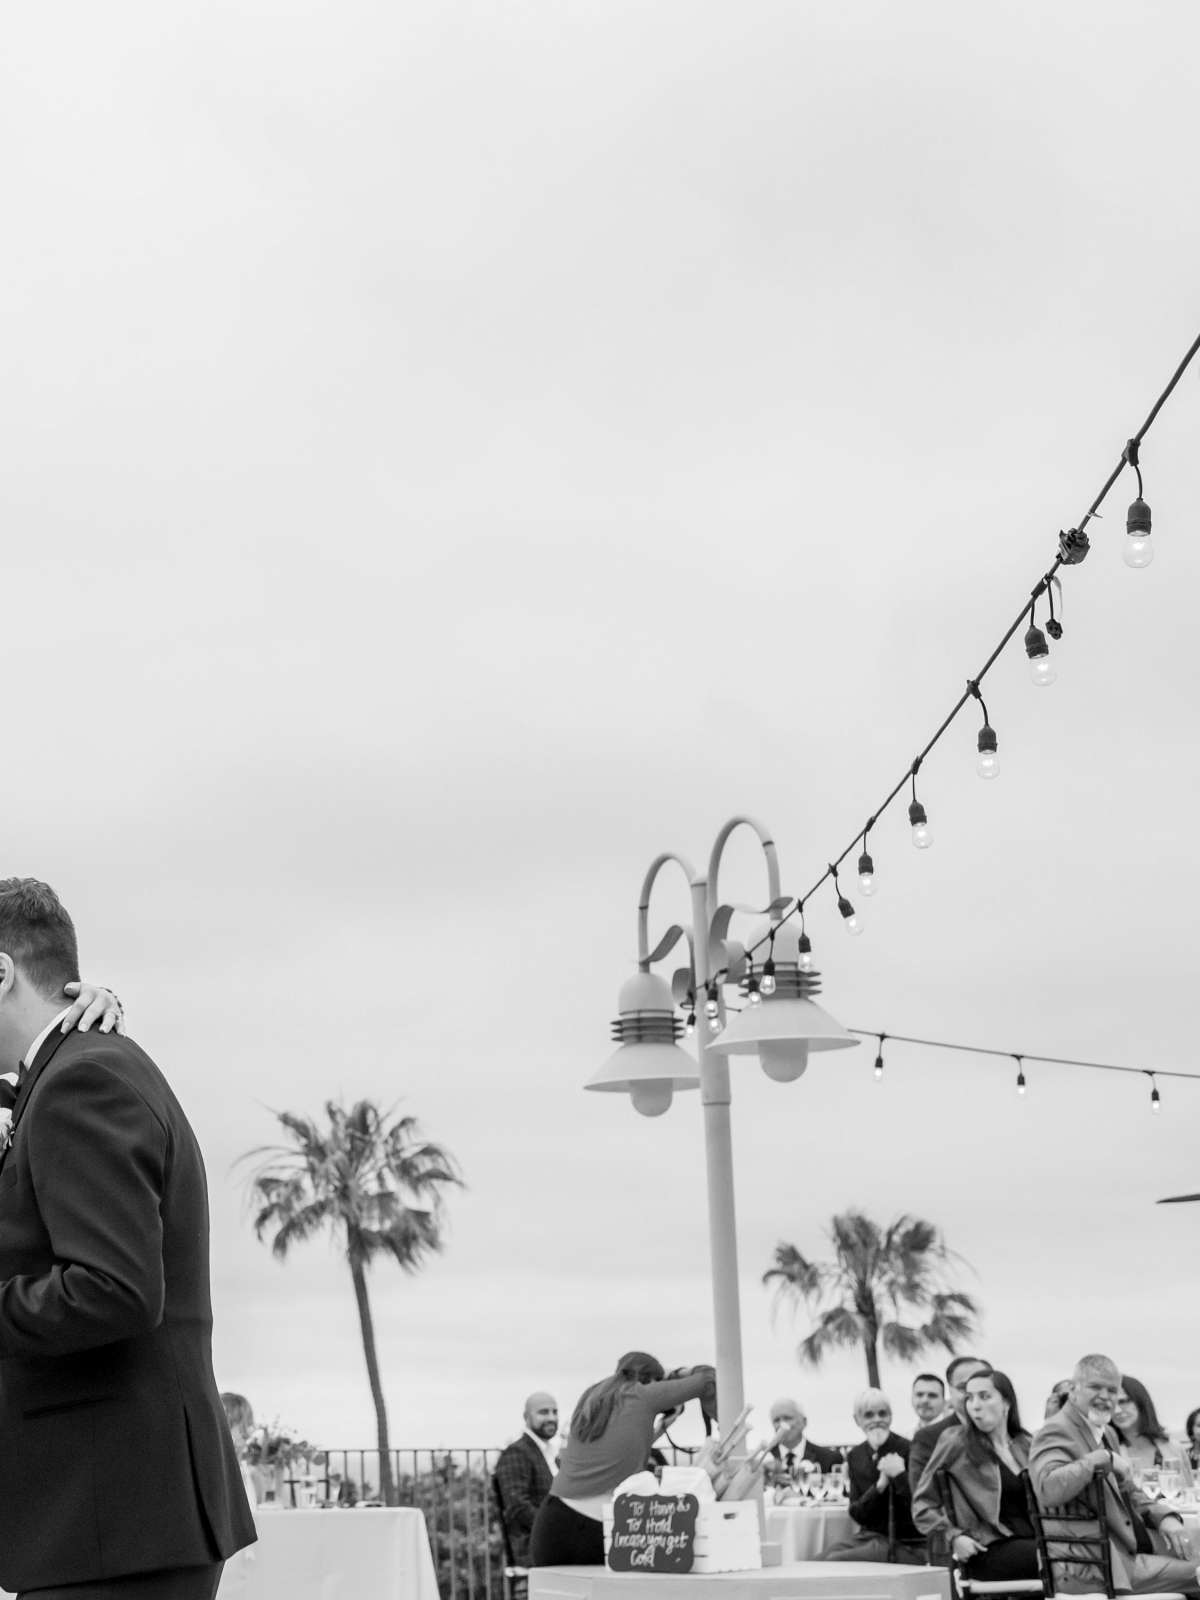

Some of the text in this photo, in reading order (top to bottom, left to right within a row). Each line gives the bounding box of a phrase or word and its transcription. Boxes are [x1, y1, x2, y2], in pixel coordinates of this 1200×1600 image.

[629, 1501, 645, 1516] To
[626, 1515, 673, 1534] To Hold
[665, 1531, 689, 1555] get
[630, 1546, 655, 1568] Cold
